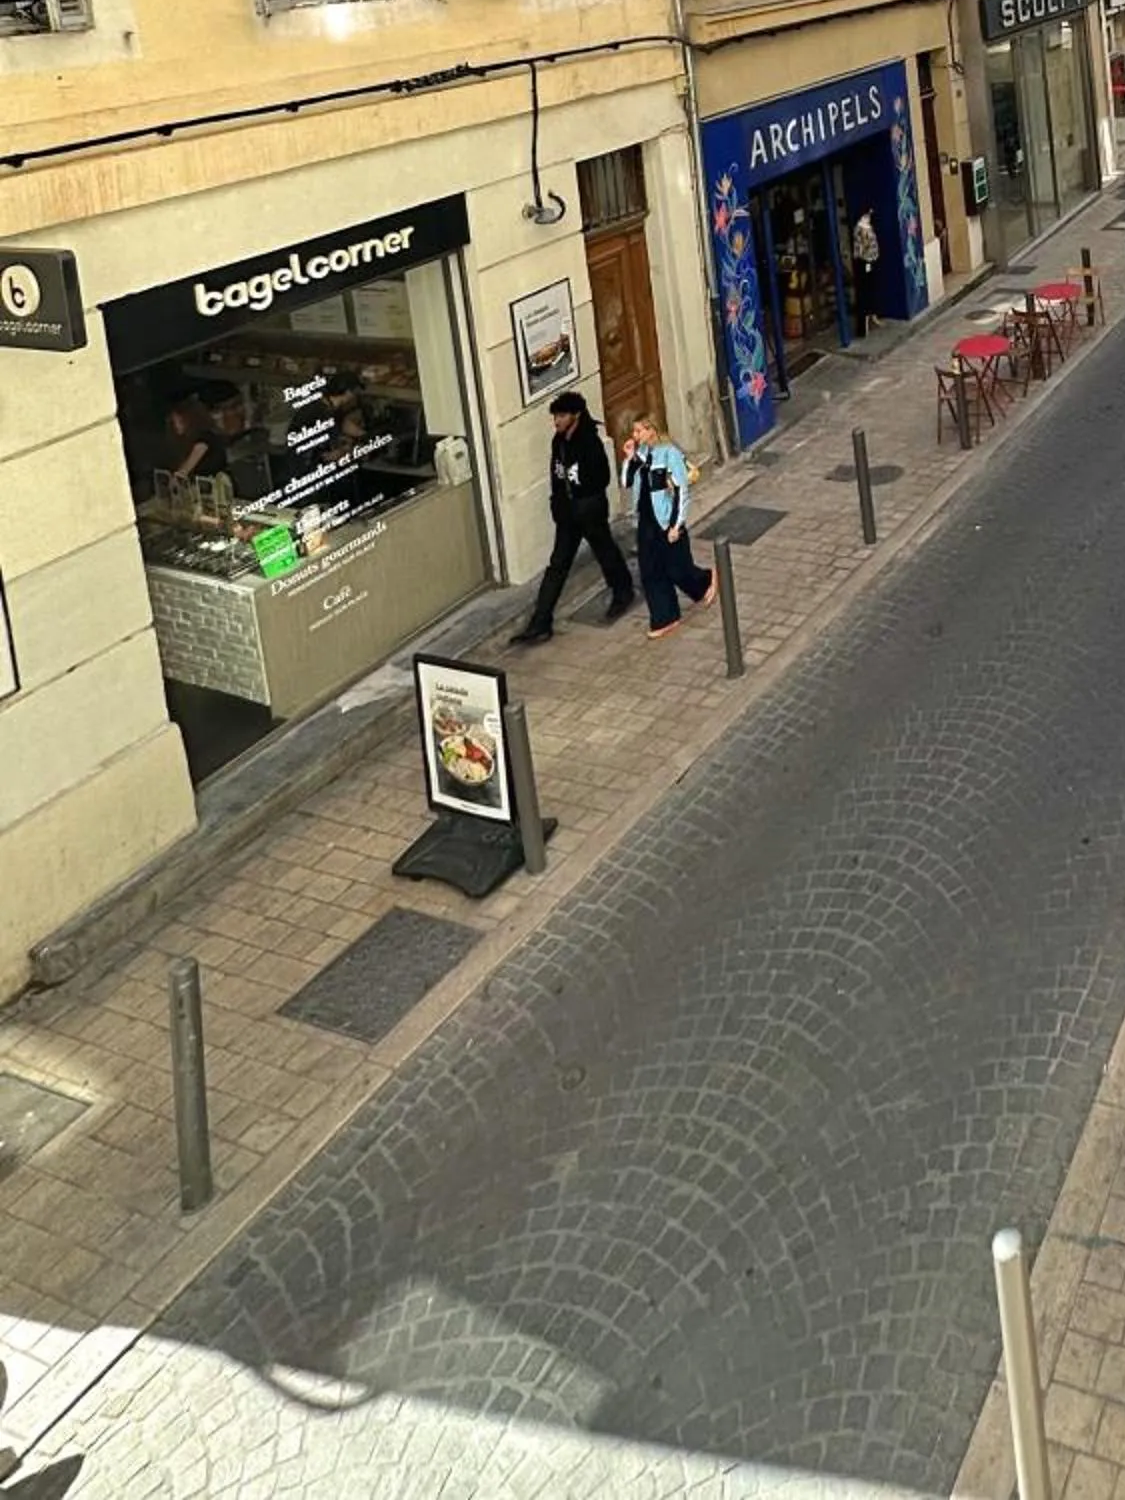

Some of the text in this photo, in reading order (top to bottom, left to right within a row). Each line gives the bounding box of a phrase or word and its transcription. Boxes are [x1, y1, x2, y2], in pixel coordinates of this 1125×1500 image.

[751, 84, 881, 169] ARCHIPELS
[283, 375, 327, 402] Bagels
[287, 418, 335, 447] Salades
[232, 489, 282, 520] Soupes
[284, 464, 337, 494] chaudes
[338, 453, 350, 467] et
[353, 434, 393, 459] froides
[271, 562, 320, 596] Donuts
[321, 521, 388, 568] gourmands
